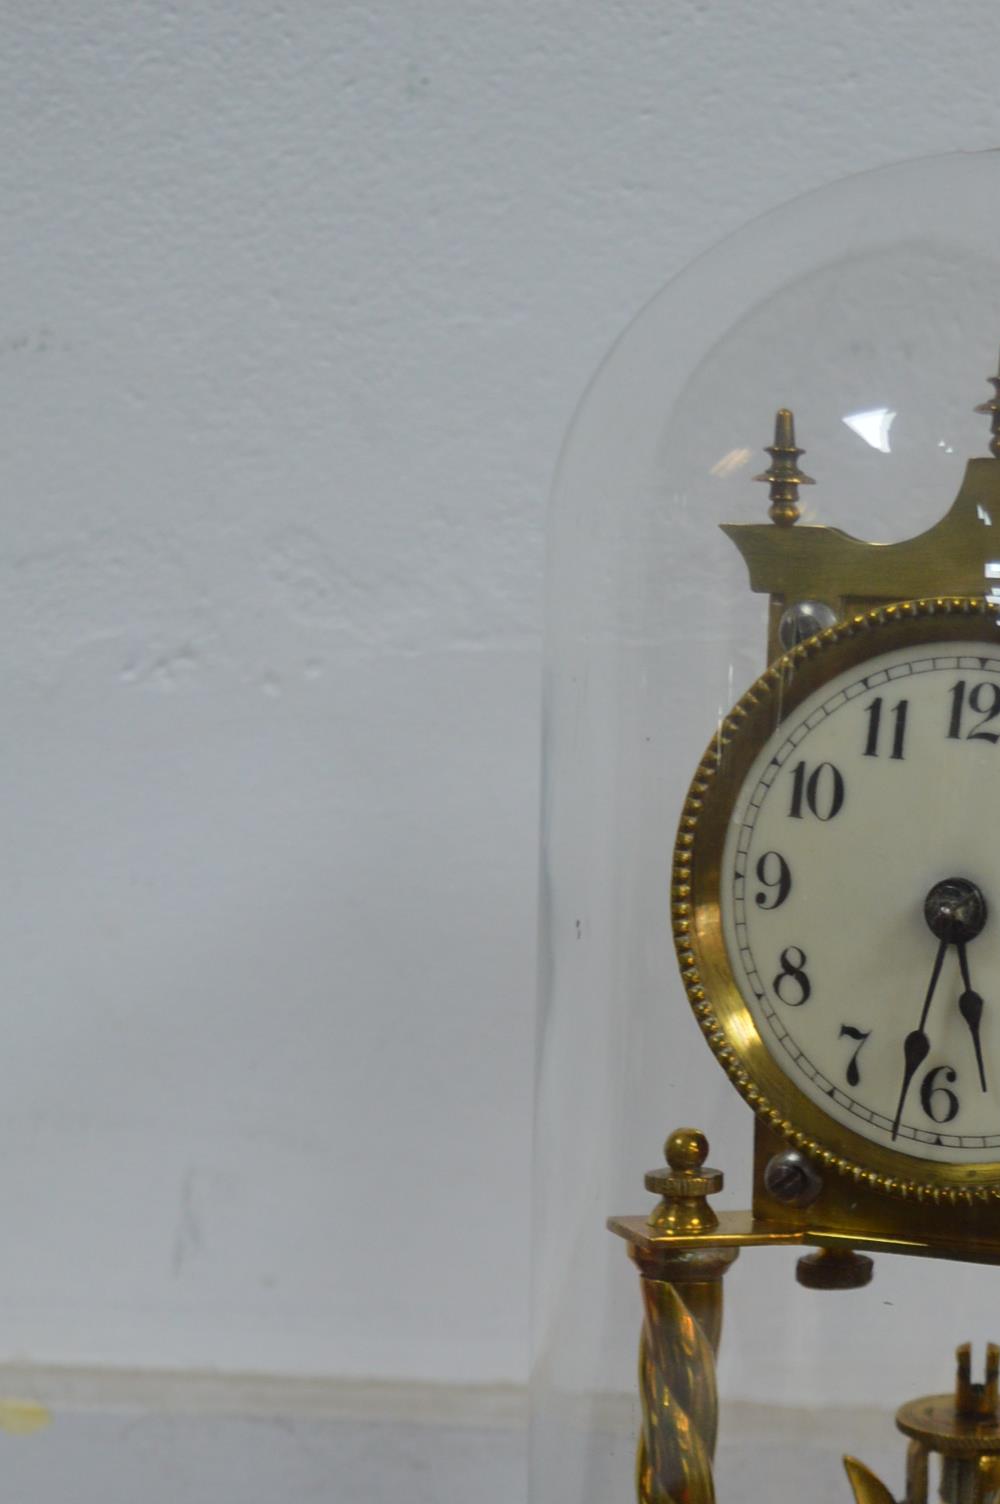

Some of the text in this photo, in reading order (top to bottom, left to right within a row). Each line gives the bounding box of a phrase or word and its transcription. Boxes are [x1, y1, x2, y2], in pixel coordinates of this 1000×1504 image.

[860, 696, 910, 760] 11
[786, 760, 847, 822] 10
[754, 850, 793, 911] 9
[771, 945, 812, 1007] 8
[839, 1022, 873, 1088] 7
[919, 1064, 960, 1124] 6
